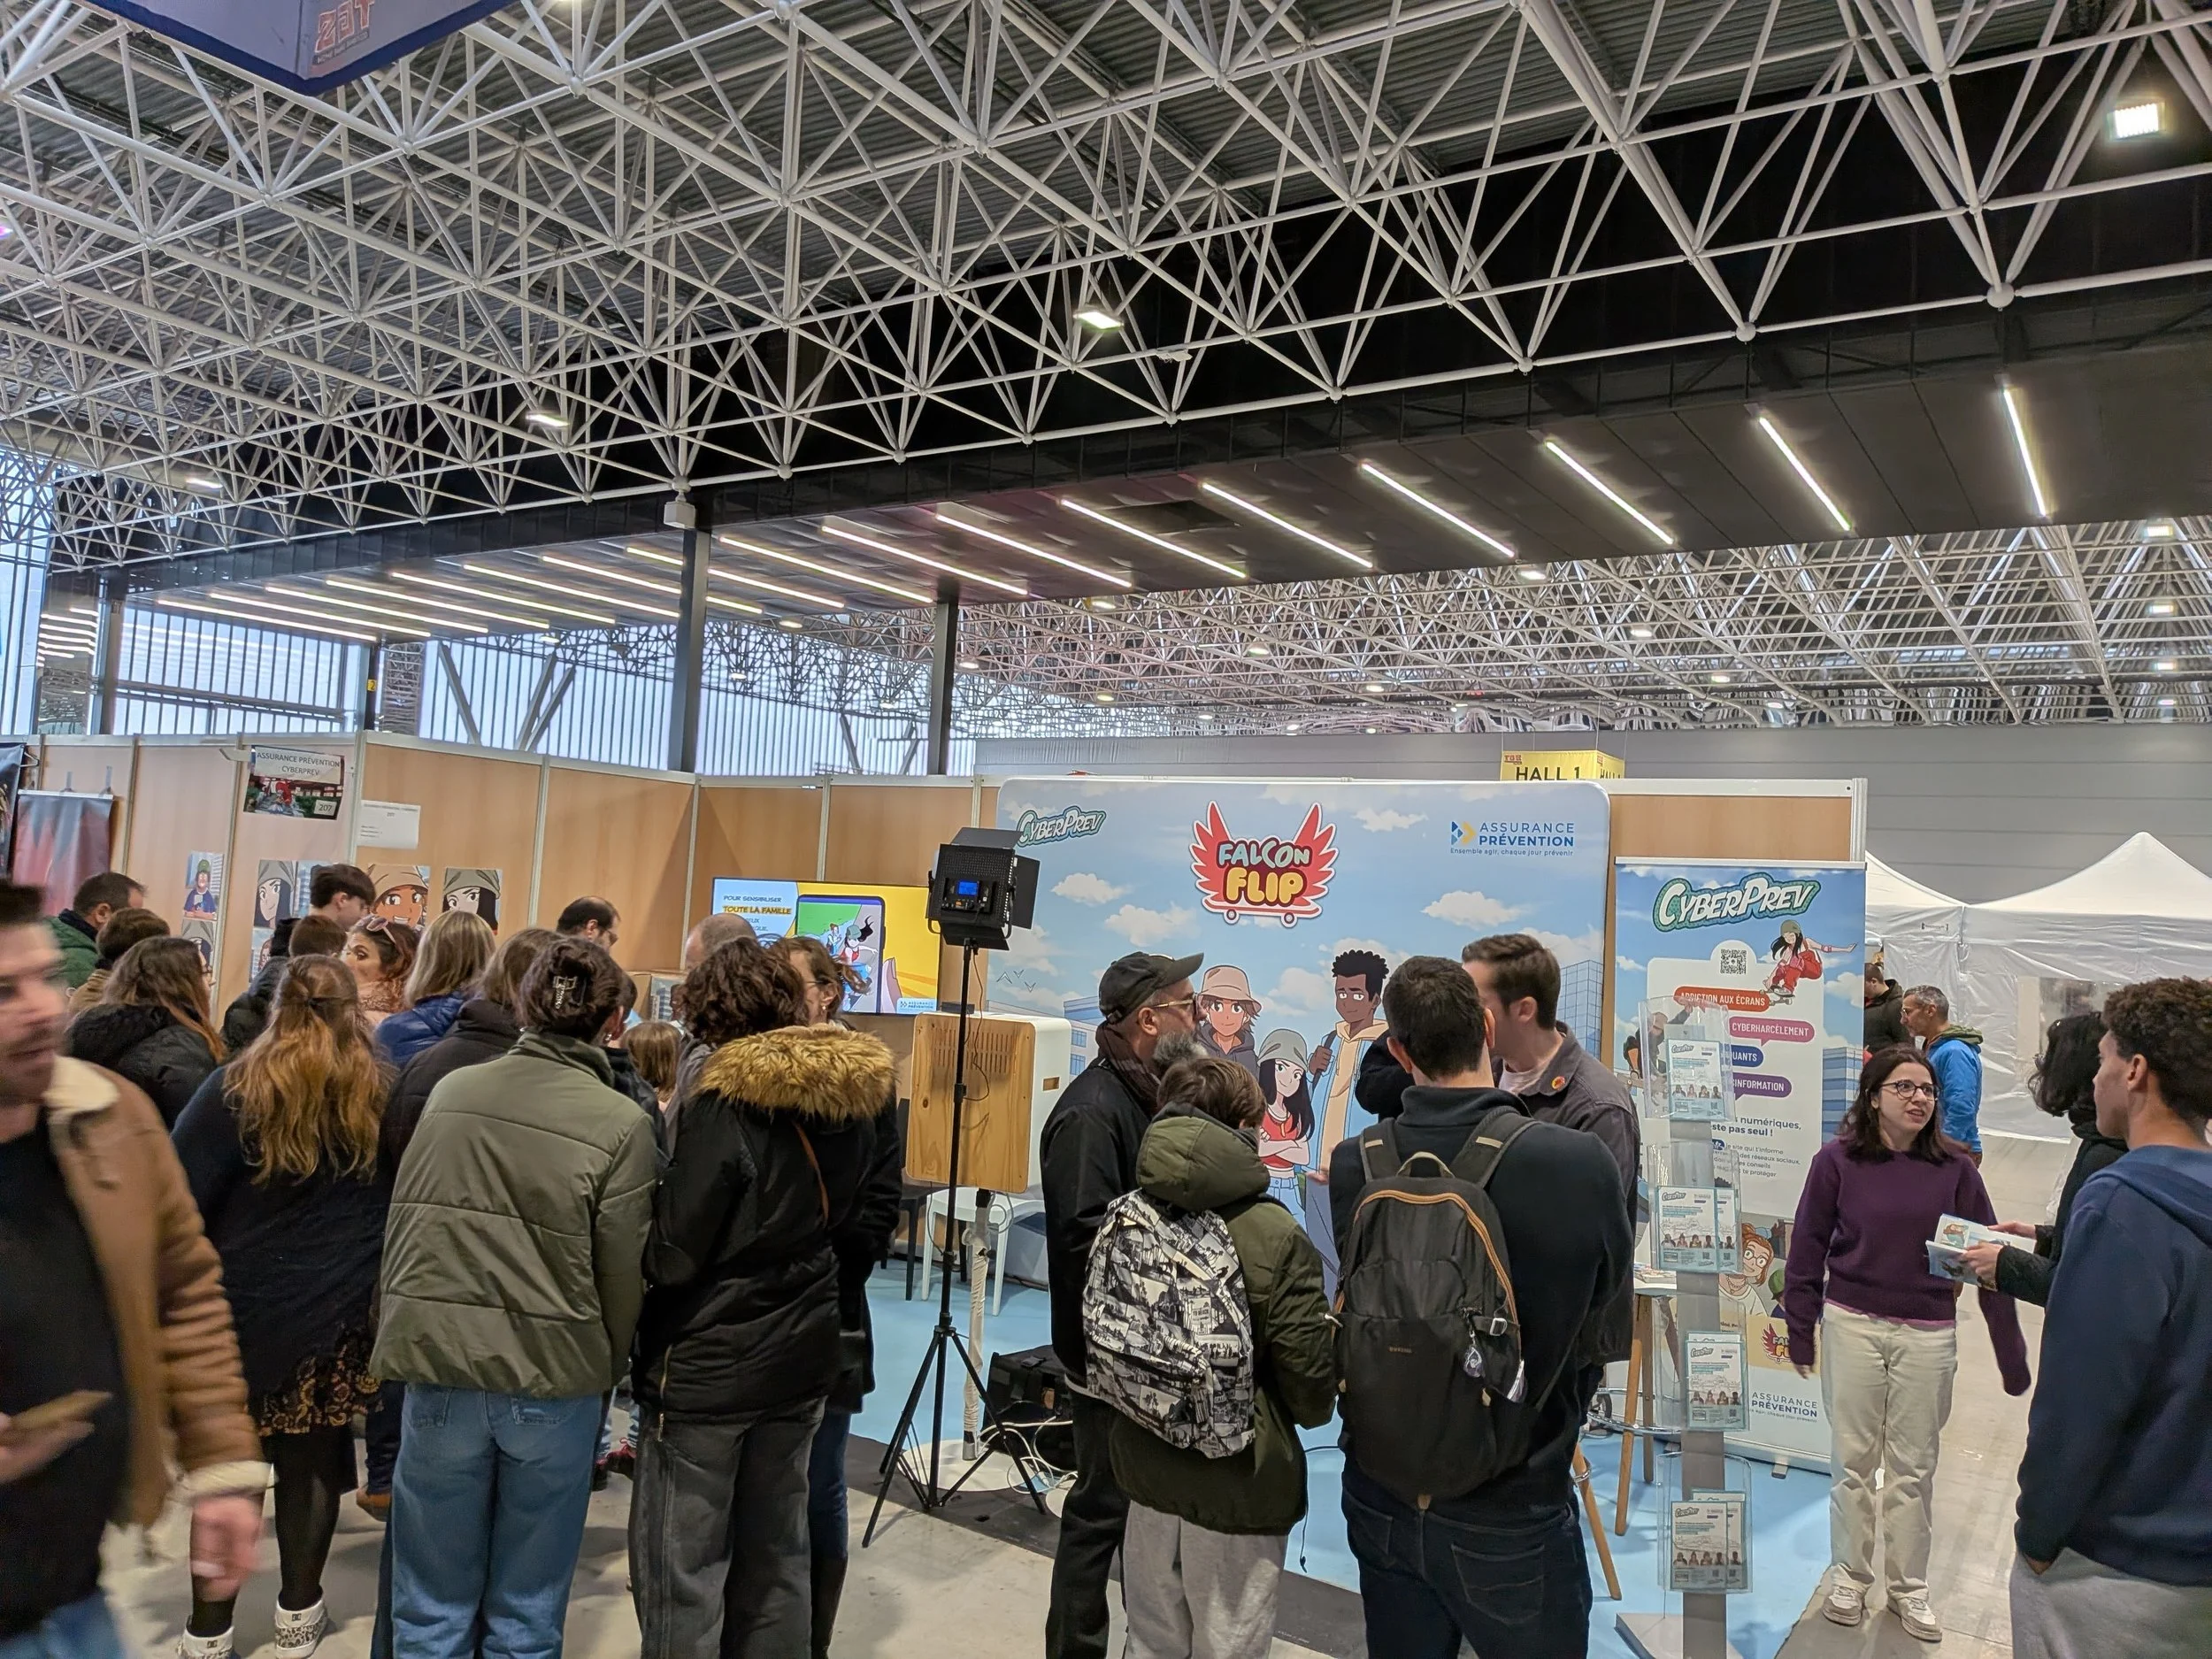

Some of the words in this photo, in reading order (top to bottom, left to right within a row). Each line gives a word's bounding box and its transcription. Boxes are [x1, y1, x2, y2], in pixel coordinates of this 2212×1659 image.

[257, 752, 297, 763] ASSURANCE
[281, 765, 320, 776] CYBERPREV
[1516, 766, 1567, 781] HALL
[1574, 766, 1580, 780] 1
[319, 803, 333, 812] 207
[1479, 822, 1575, 833] ASSURANCE
[1479, 833, 1574, 847] PRÉVENTION
[1218, 841, 1310, 869] FALCON
[1226, 867, 1304, 904] FLIP
[1719, 995, 1734, 1004] AUX
[1736, 995, 1765, 1006] ÉCRANS
[1732, 1051, 1757, 1062] UANTS
[1711, 1123, 1726, 1132] ste
[1728, 1125, 1746, 1134] pas
[1747, 1127, 1768, 1136] seul
[1740, 1116, 1801, 1130] numériques,
[1772, 1336, 1789, 1346] FAL
[1752, 1392, 1817, 1409] ASSURANCE
[1751, 1400, 1817, 1417] PRÉVENTION
